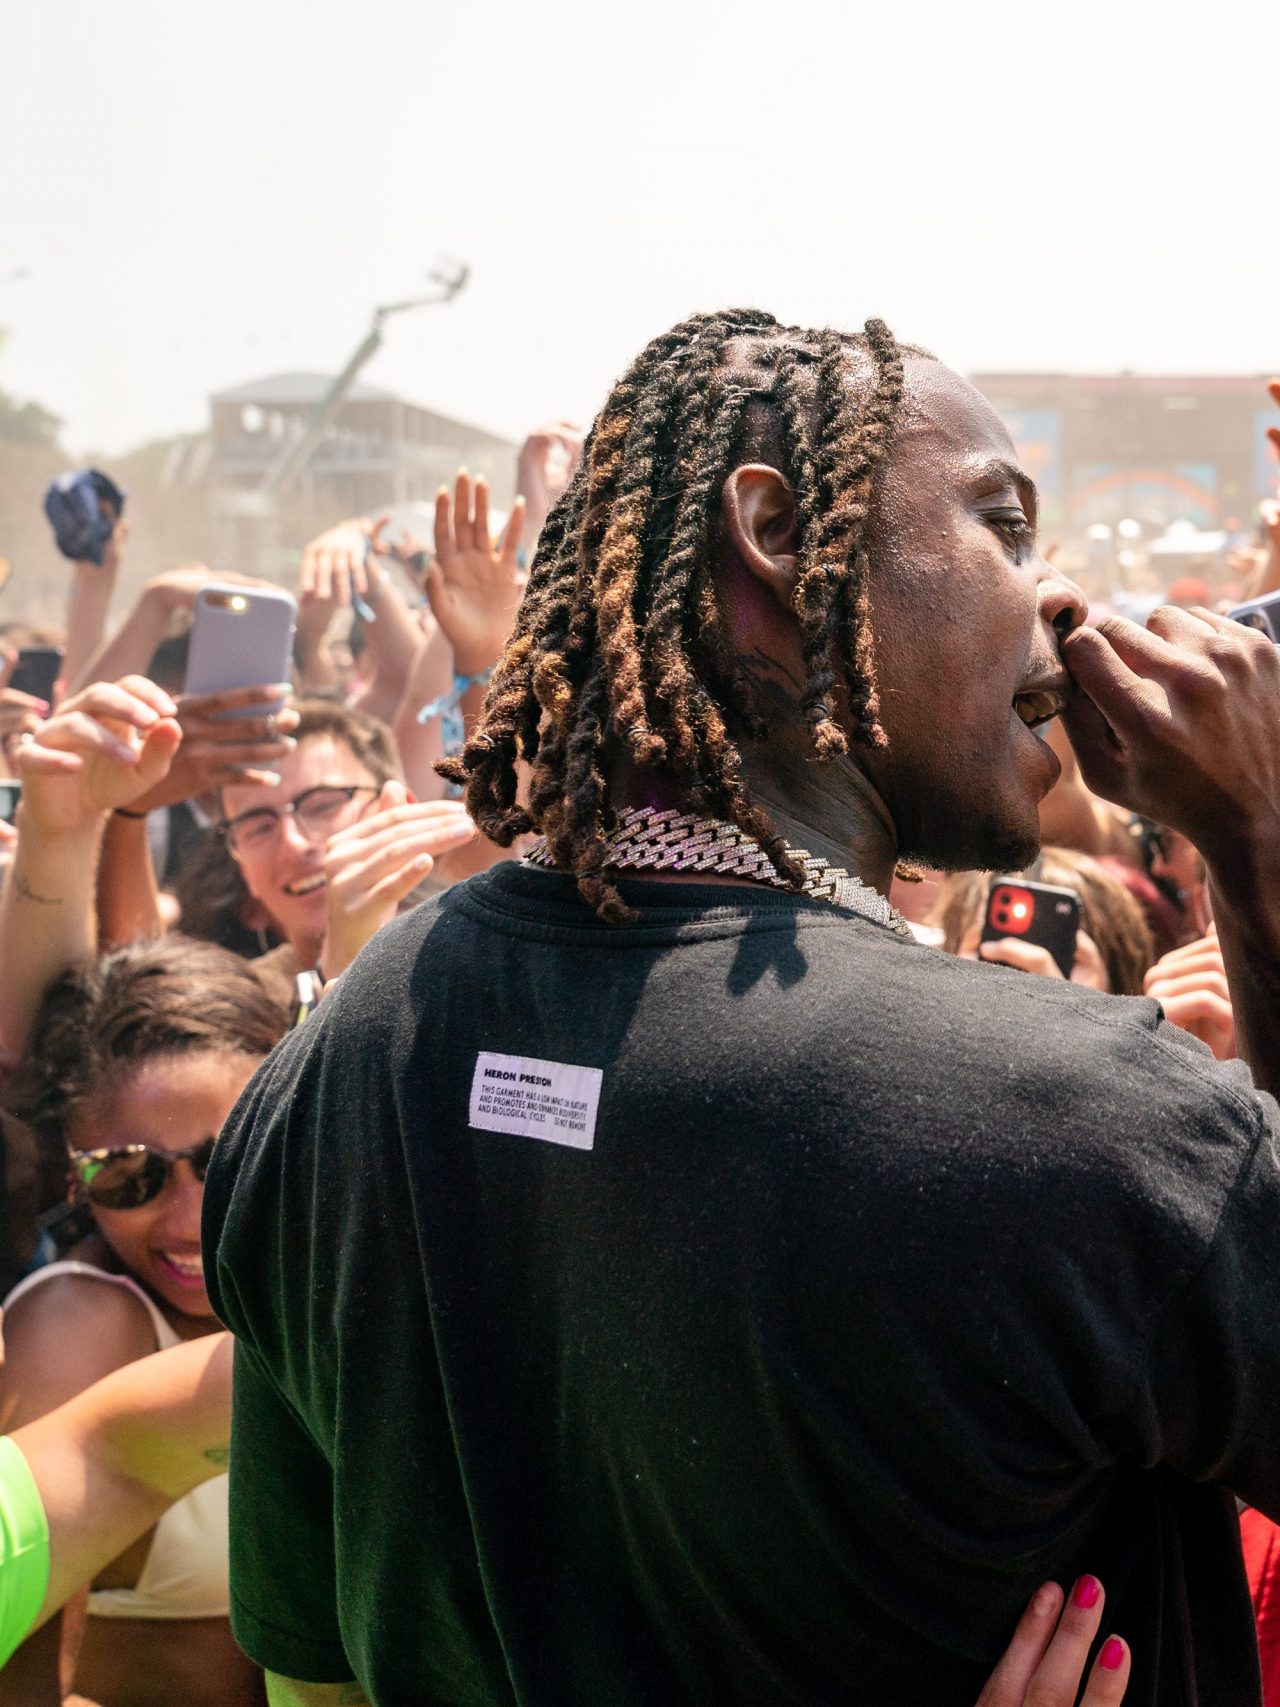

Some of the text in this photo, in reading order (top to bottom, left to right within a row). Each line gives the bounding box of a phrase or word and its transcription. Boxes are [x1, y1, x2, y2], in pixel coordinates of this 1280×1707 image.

[484, 1068, 551, 1087] HERON PRESTON
[482, 1085, 495, 1094] THIS
[496, 1088, 524, 1098] GARMENT
[526, 1092, 536, 1100] HAS
[479, 1095, 492, 1103] AND
[494, 1096, 526, 1108] PROMOTES
[526, 1101, 537, 1111] AND
[478, 1104, 545, 1122] AND BIOLOGICAL CYCLES
